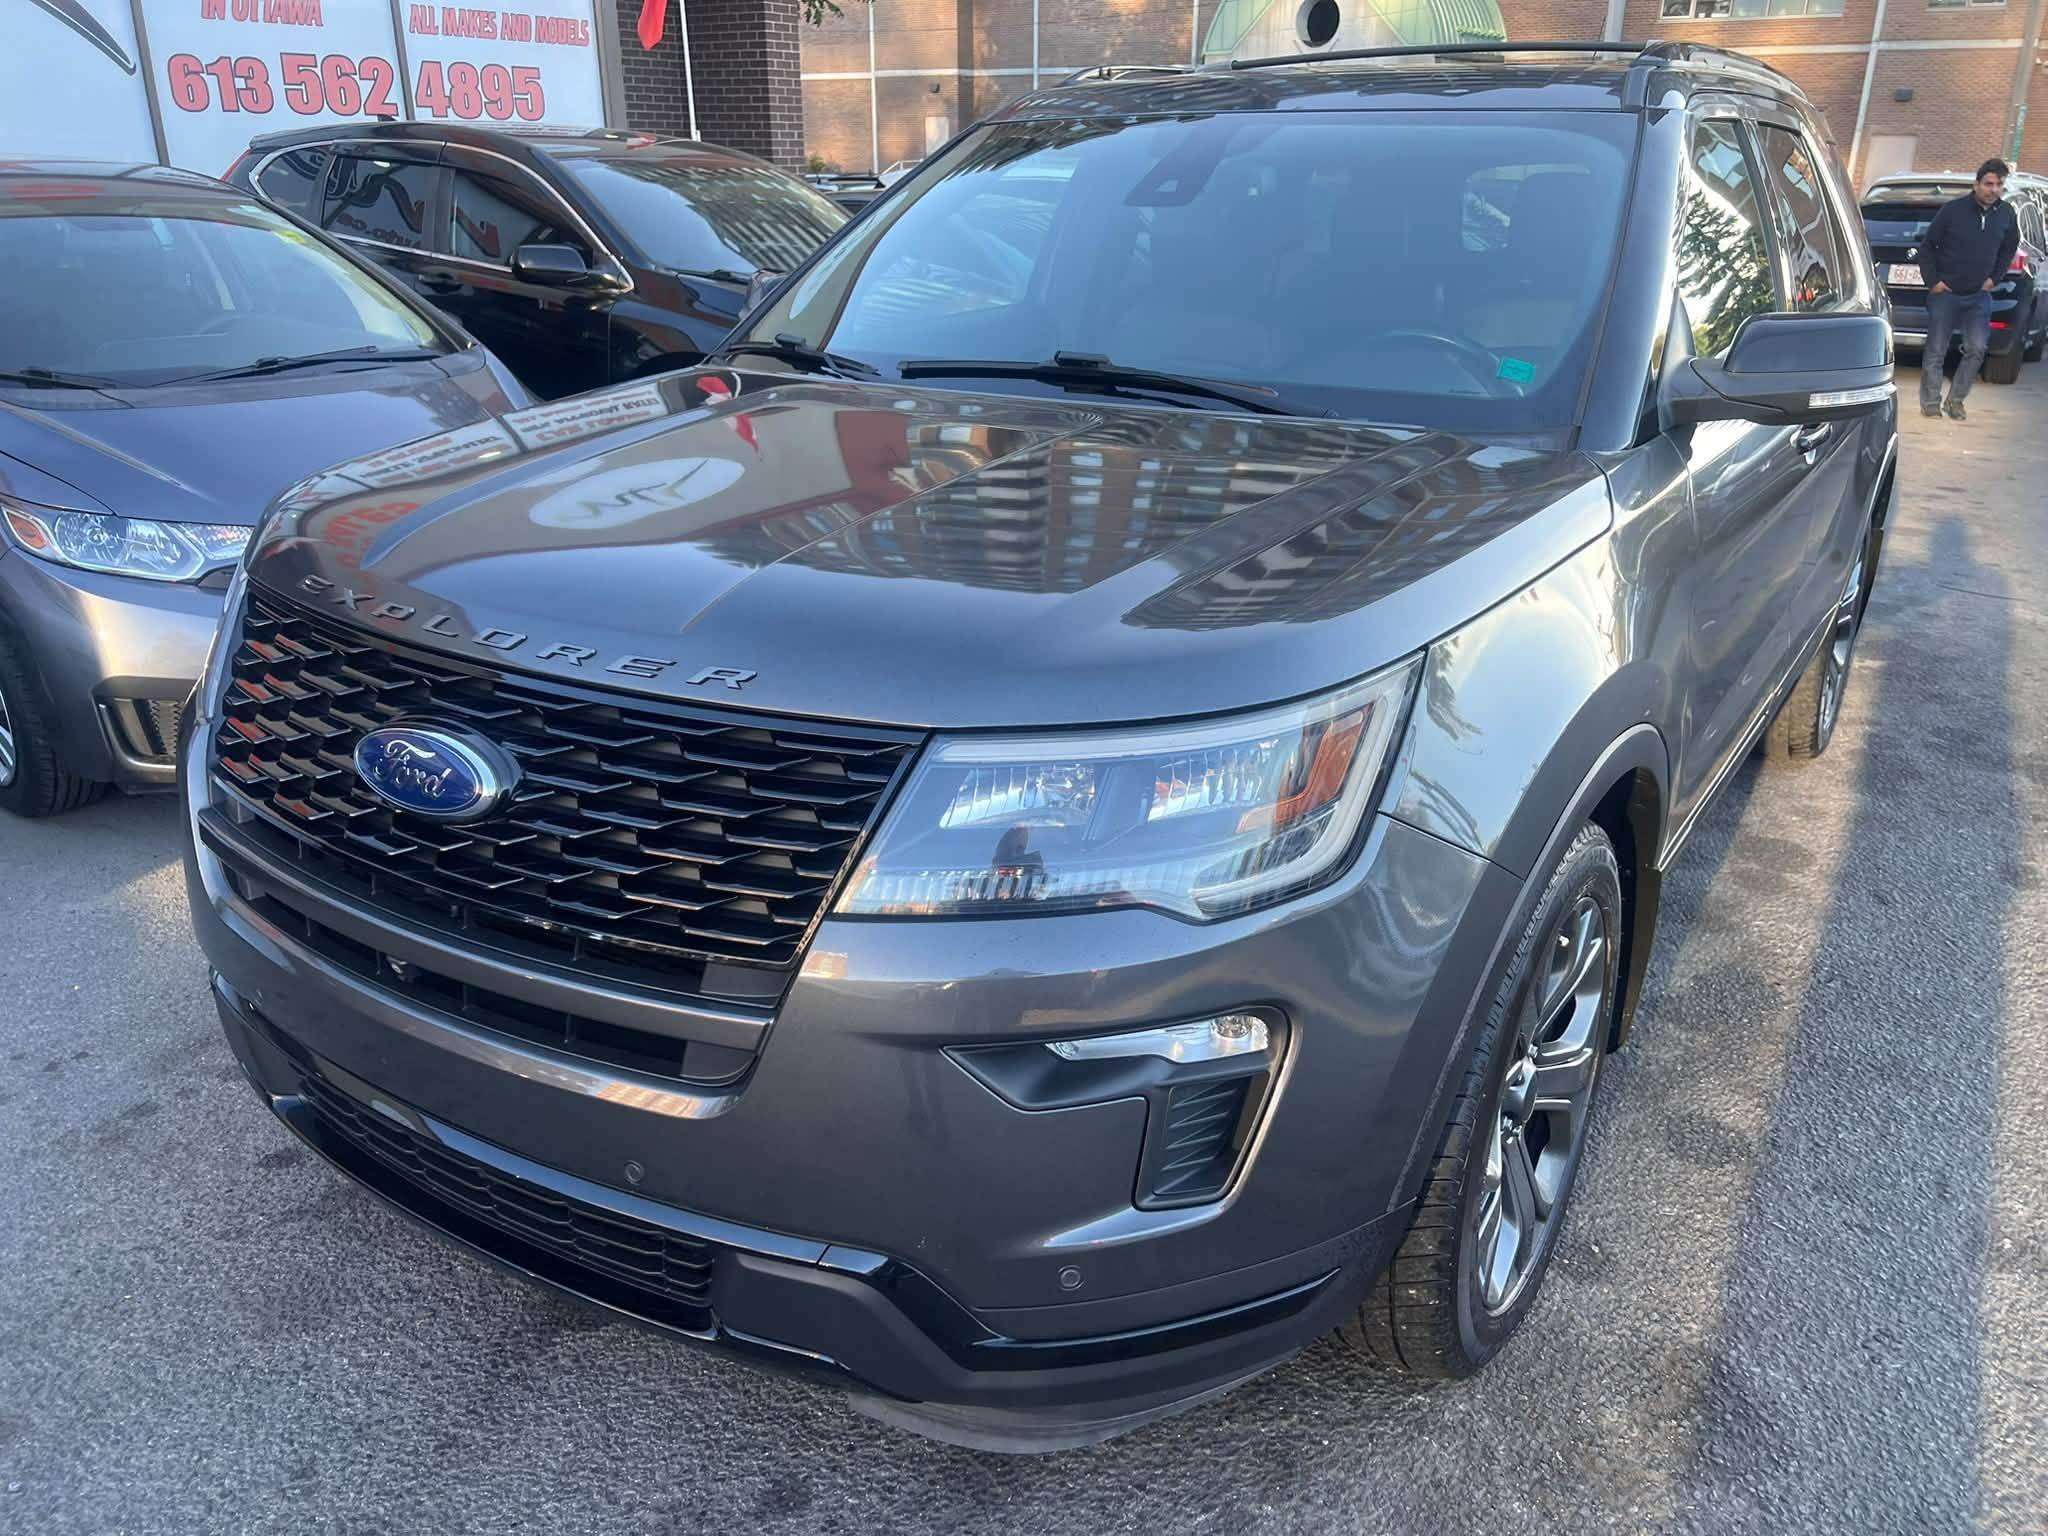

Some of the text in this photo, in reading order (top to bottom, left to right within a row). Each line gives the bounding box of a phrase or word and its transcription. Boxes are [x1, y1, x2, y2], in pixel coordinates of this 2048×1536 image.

[201, 0, 324, 27] IN OTTAWA
[409, 4, 590, 47] ALL MAKES AND MODELS
[167, 52, 546, 121] 613 562 4895
[300, 573, 759, 690] EXPLORER
[373, 739, 453, 799] Ford
